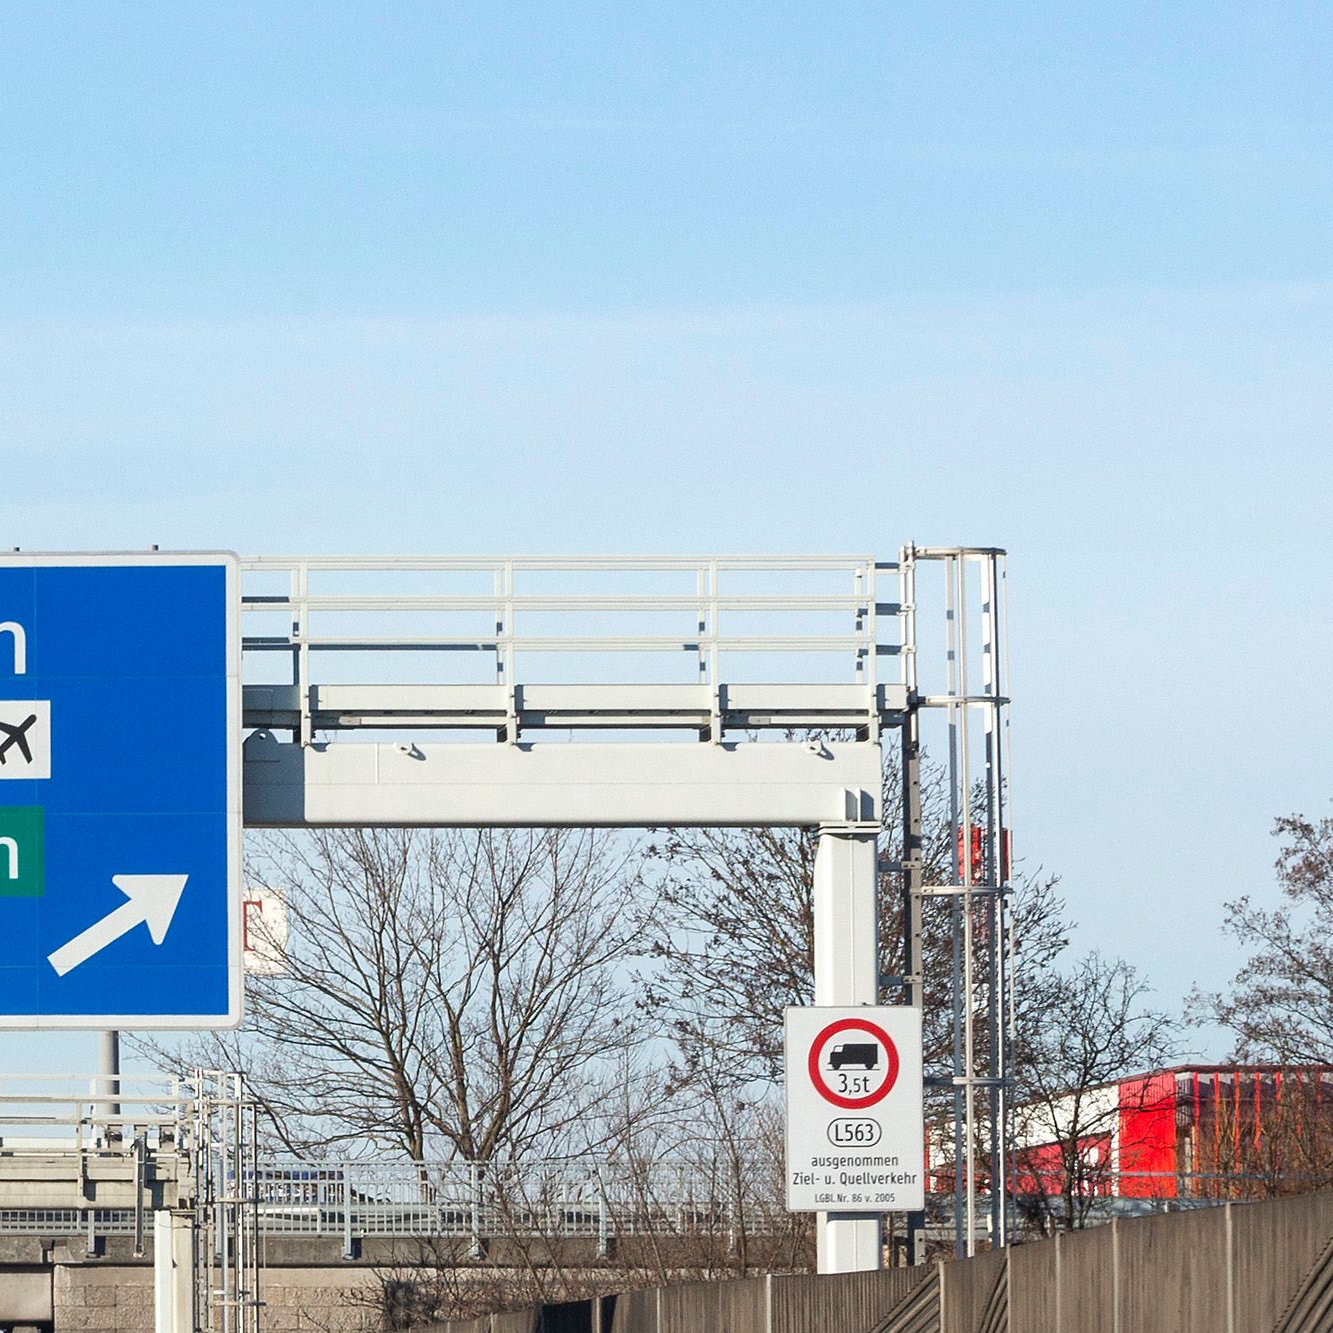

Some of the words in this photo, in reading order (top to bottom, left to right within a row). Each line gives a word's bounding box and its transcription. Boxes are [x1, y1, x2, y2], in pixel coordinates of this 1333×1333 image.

[834, 1123, 874, 1142] L563
[811, 1156, 899, 1170] ausgenommen
[792, 1171, 820, 1185] Ziel-
[824, 1175, 836, 1185] u.
[839, 1171, 918, 1187] Quellverkehr
[874, 1192, 896, 1203] 2005
